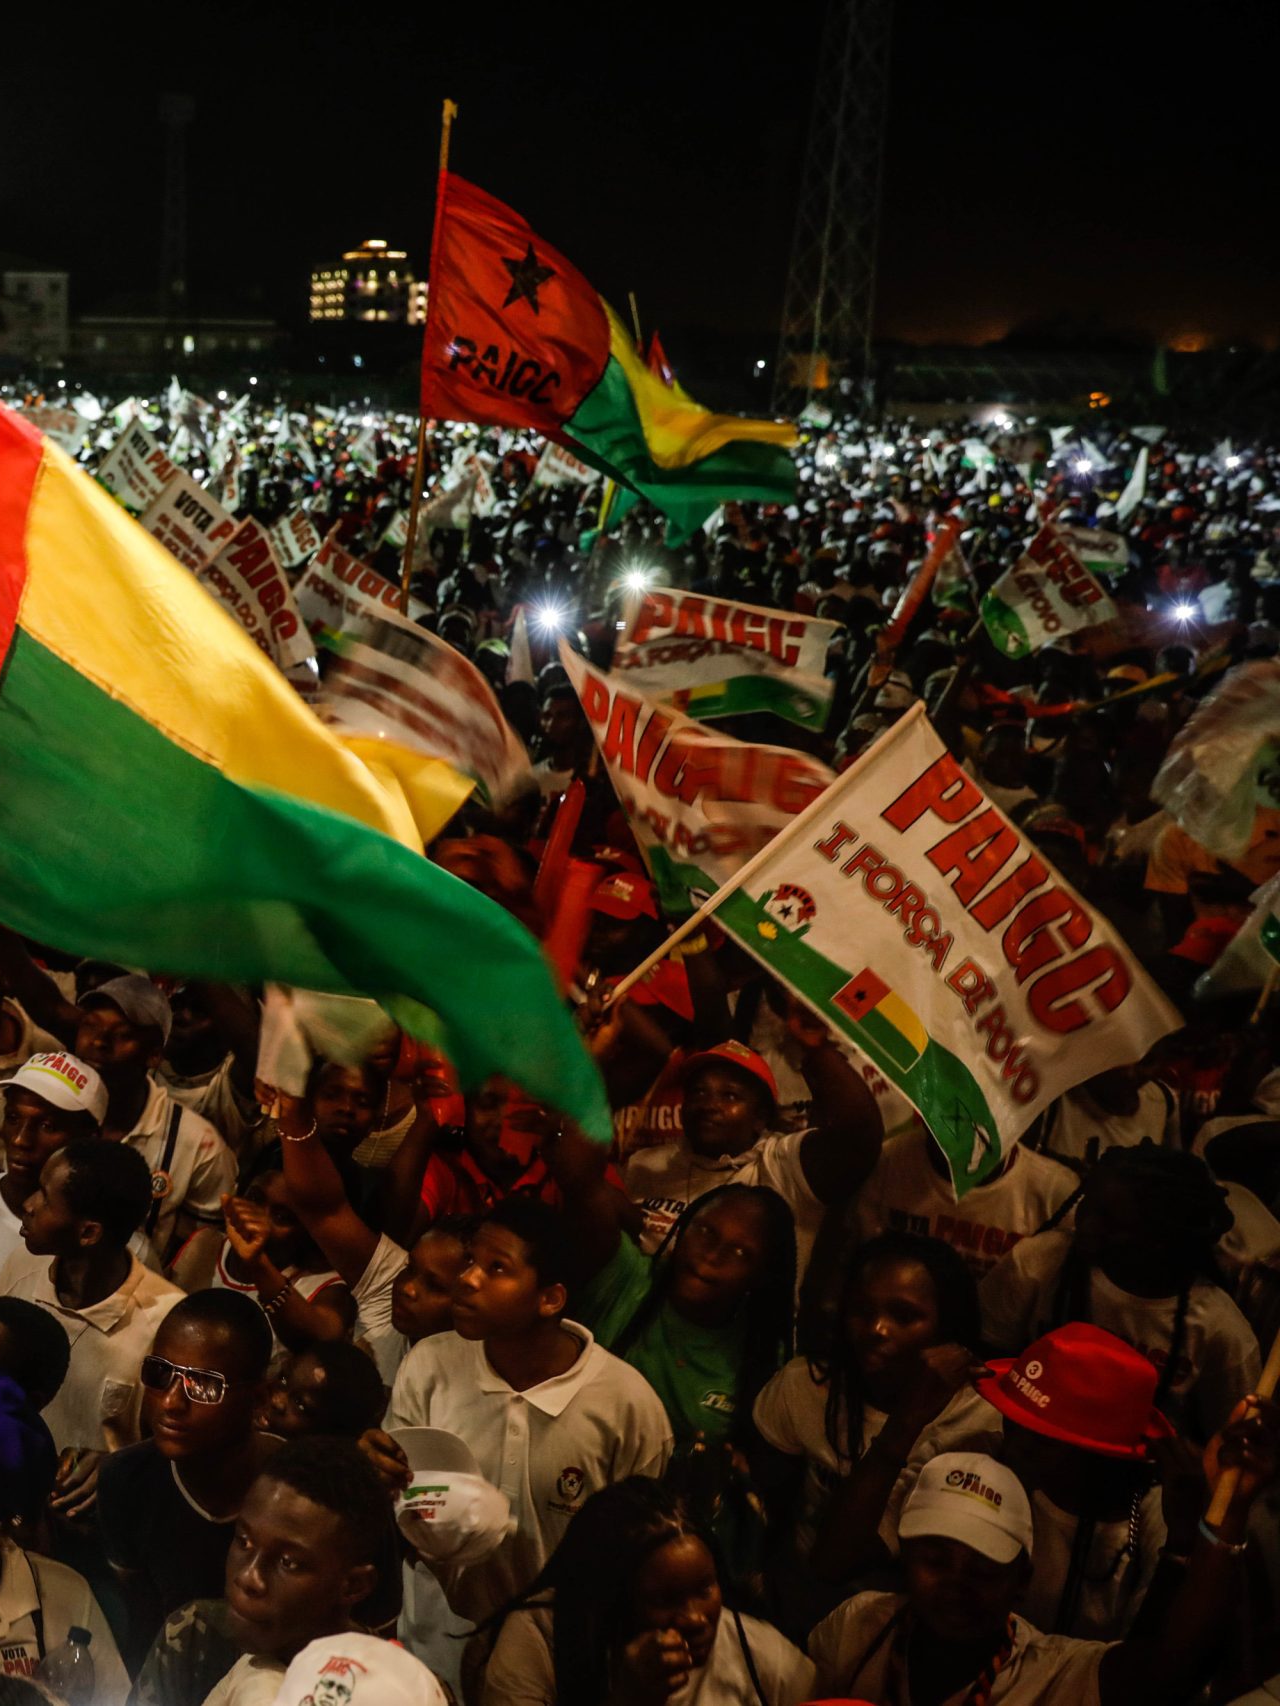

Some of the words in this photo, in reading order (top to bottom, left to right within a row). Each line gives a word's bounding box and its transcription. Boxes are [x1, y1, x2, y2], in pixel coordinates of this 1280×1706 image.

[450, 336, 561, 404] PAIGC
[144, 448, 181, 485] PAI
[173, 489, 214, 533] VOTA
[226, 522, 298, 644] PAIGC
[629, 592, 806, 668] PAIGC
[880, 750, 1132, 1035] PAIGC
[841, 843, 954, 973] FORÇA
[976, 1004, 1040, 1104] POVO
[43, 1055, 88, 1090] PAIGC
[1016, 1377, 1051, 1408] PAIGC
[962, 1477, 1002, 1506] PAIGC
[1, 1647, 27, 1661] VOTA
[4, 1658, 40, 1676] PAI
